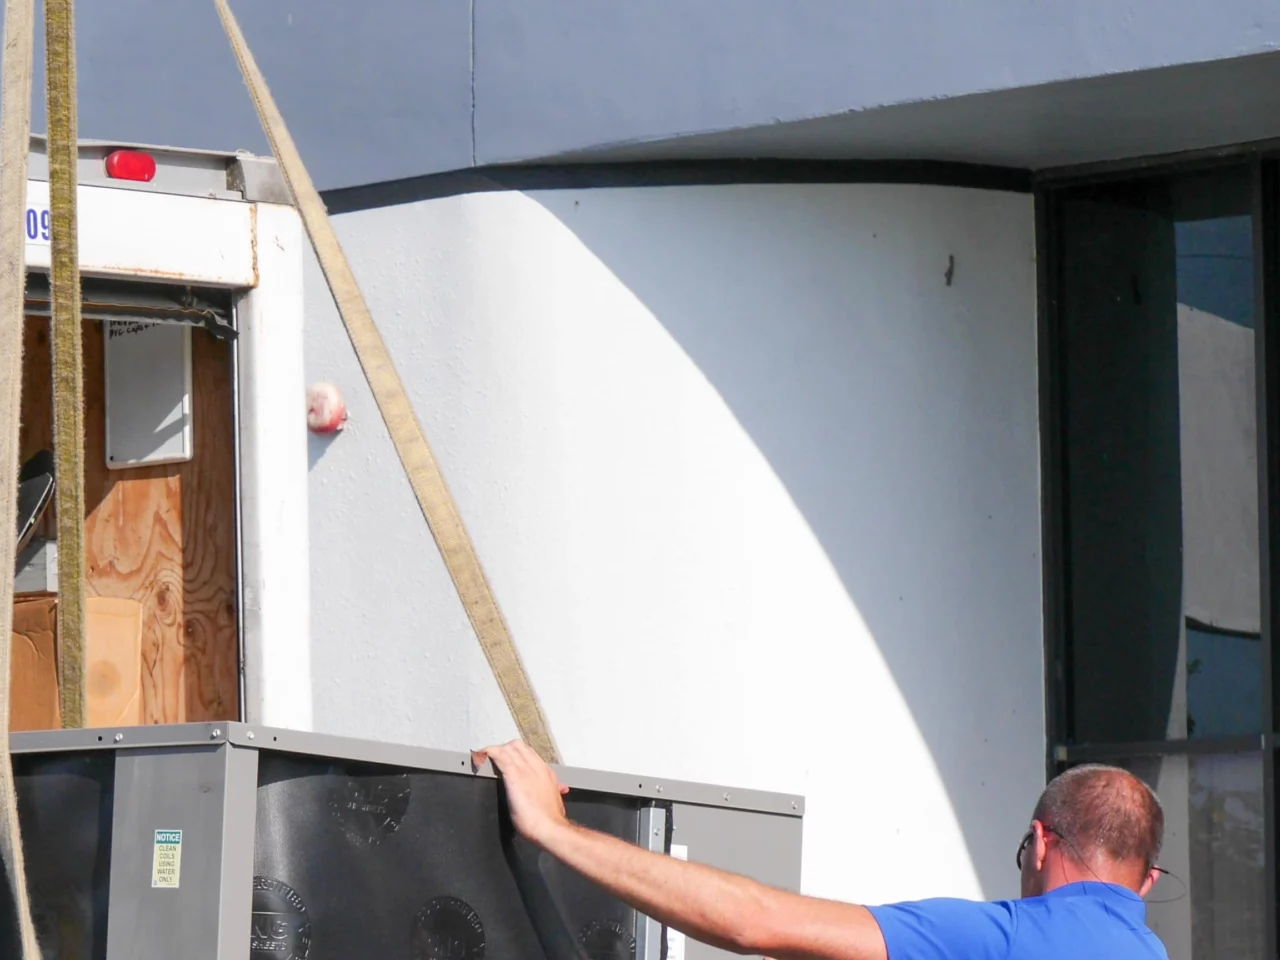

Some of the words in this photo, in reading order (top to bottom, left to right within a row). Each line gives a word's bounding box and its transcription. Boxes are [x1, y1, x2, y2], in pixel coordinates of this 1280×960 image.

[156, 832, 180, 842] NOTICE
[158, 844, 177, 852] CLEAN
[159, 852, 175, 860] COILS
[250, 919, 289, 940] NG
